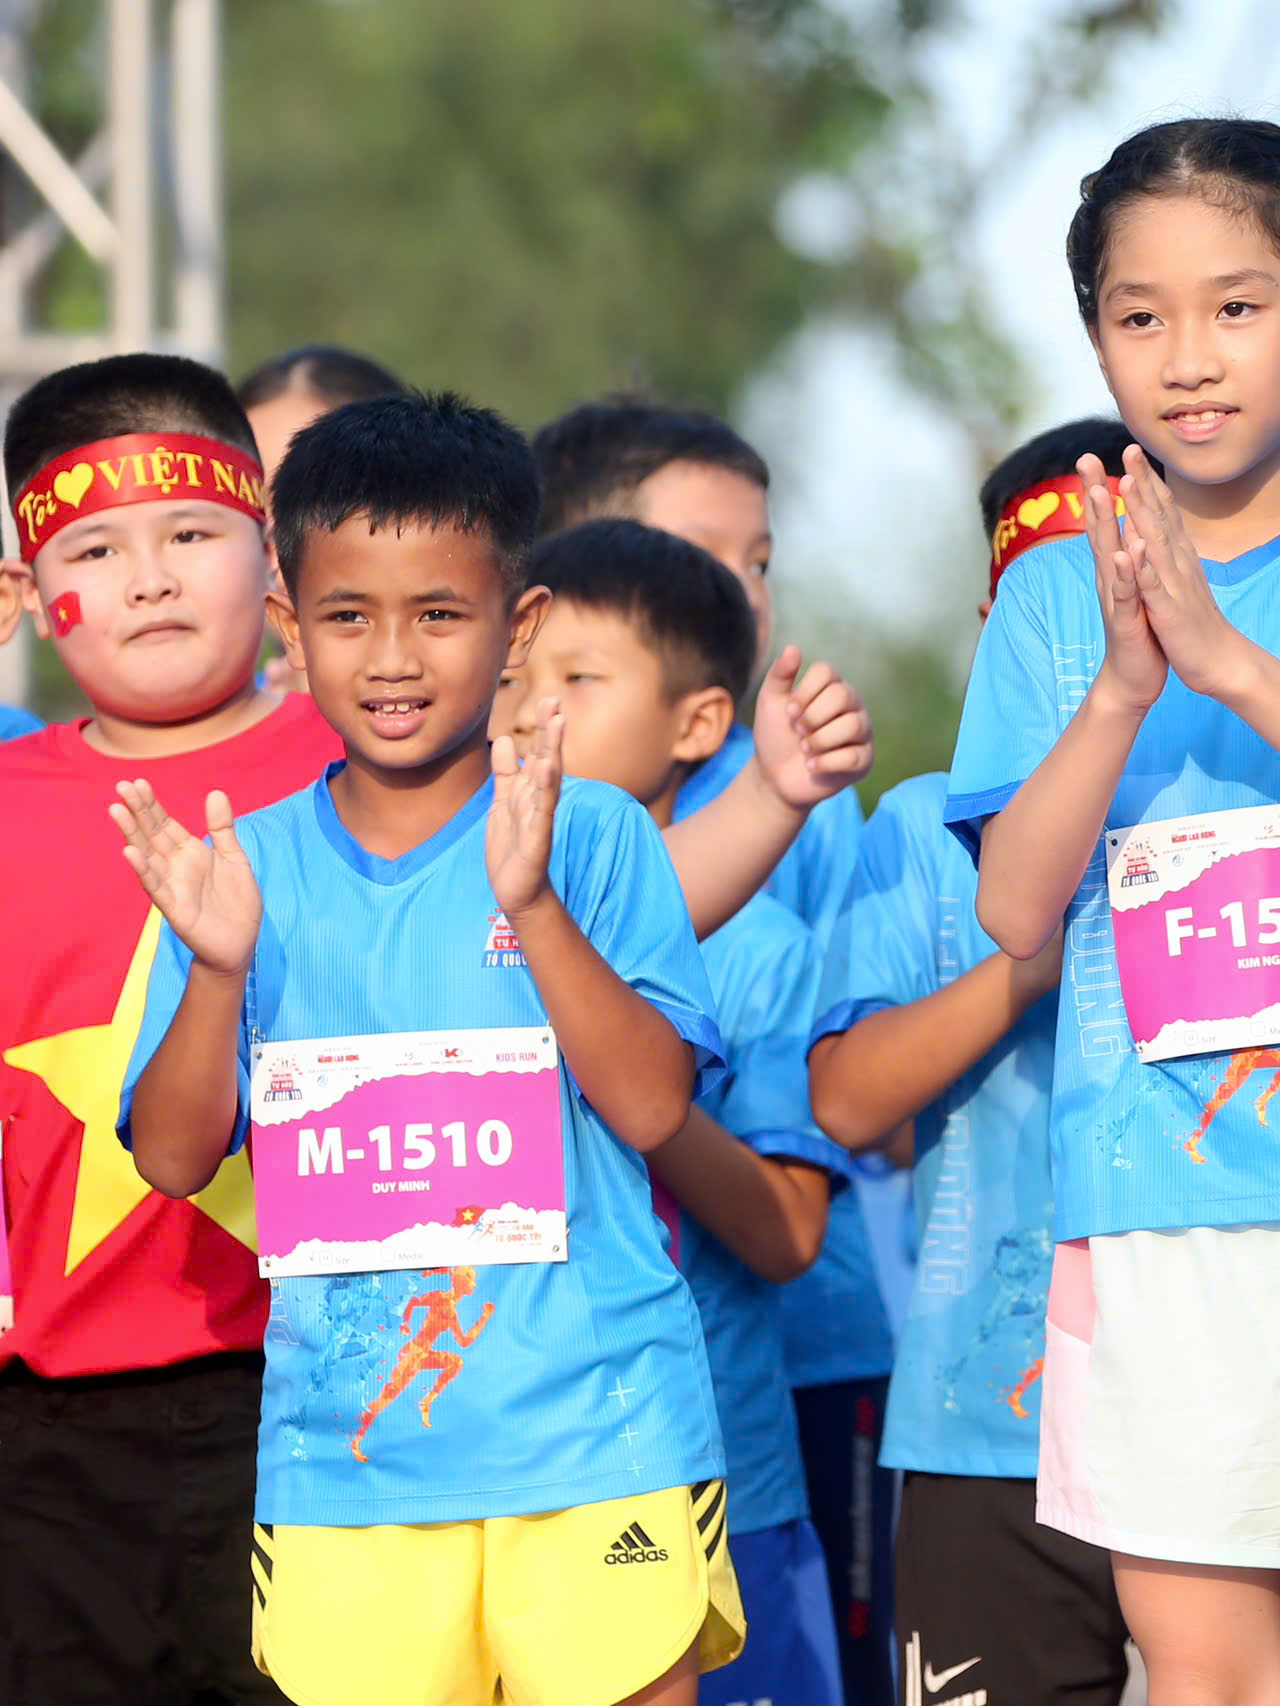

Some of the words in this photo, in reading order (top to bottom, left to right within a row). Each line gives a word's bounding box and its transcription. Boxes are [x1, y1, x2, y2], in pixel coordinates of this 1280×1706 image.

[19, 491, 57, 543] Tôi
[97, 446, 203, 494] VIỆT
[1237, 957, 1260, 969] KIM
[496, 1053, 516, 1062] KIDS
[519, 1052, 537, 1061] RUN
[297, 1119, 513, 1177] M-1510
[372, 1181, 396, 1194] DUY
[398, 1180, 431, 1192] MINH
[604, 1548, 669, 1565] adidas
